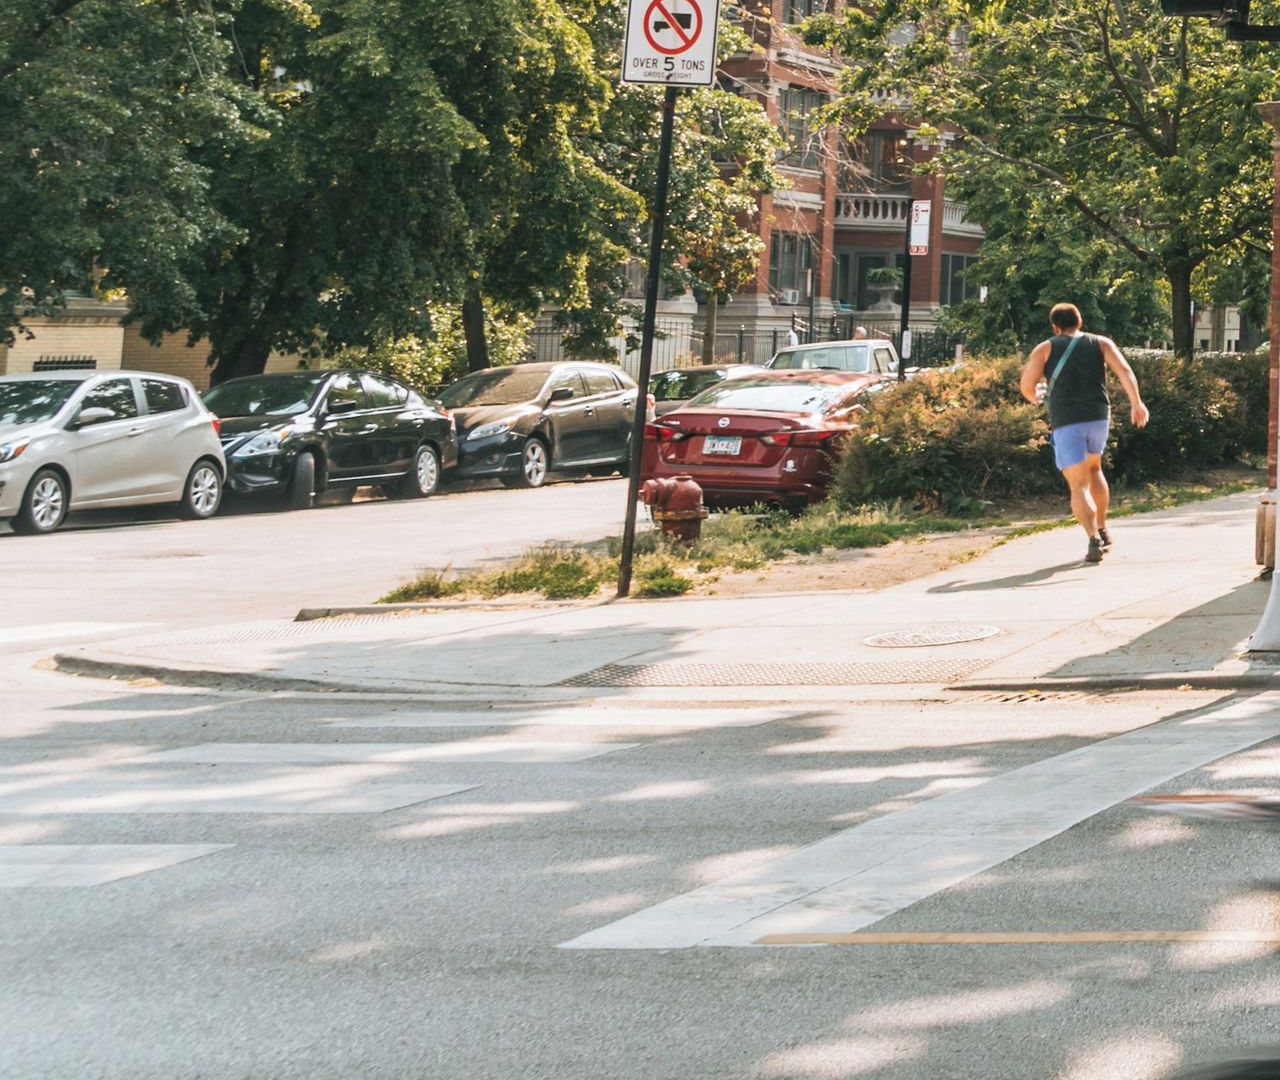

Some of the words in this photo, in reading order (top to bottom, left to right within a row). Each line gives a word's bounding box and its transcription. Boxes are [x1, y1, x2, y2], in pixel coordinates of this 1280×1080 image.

[632, 57, 658, 70] OVER
[663, 56, 675, 71] 5
[681, 59, 705, 71] TONS
[666, 72, 692, 80] EIGHT
